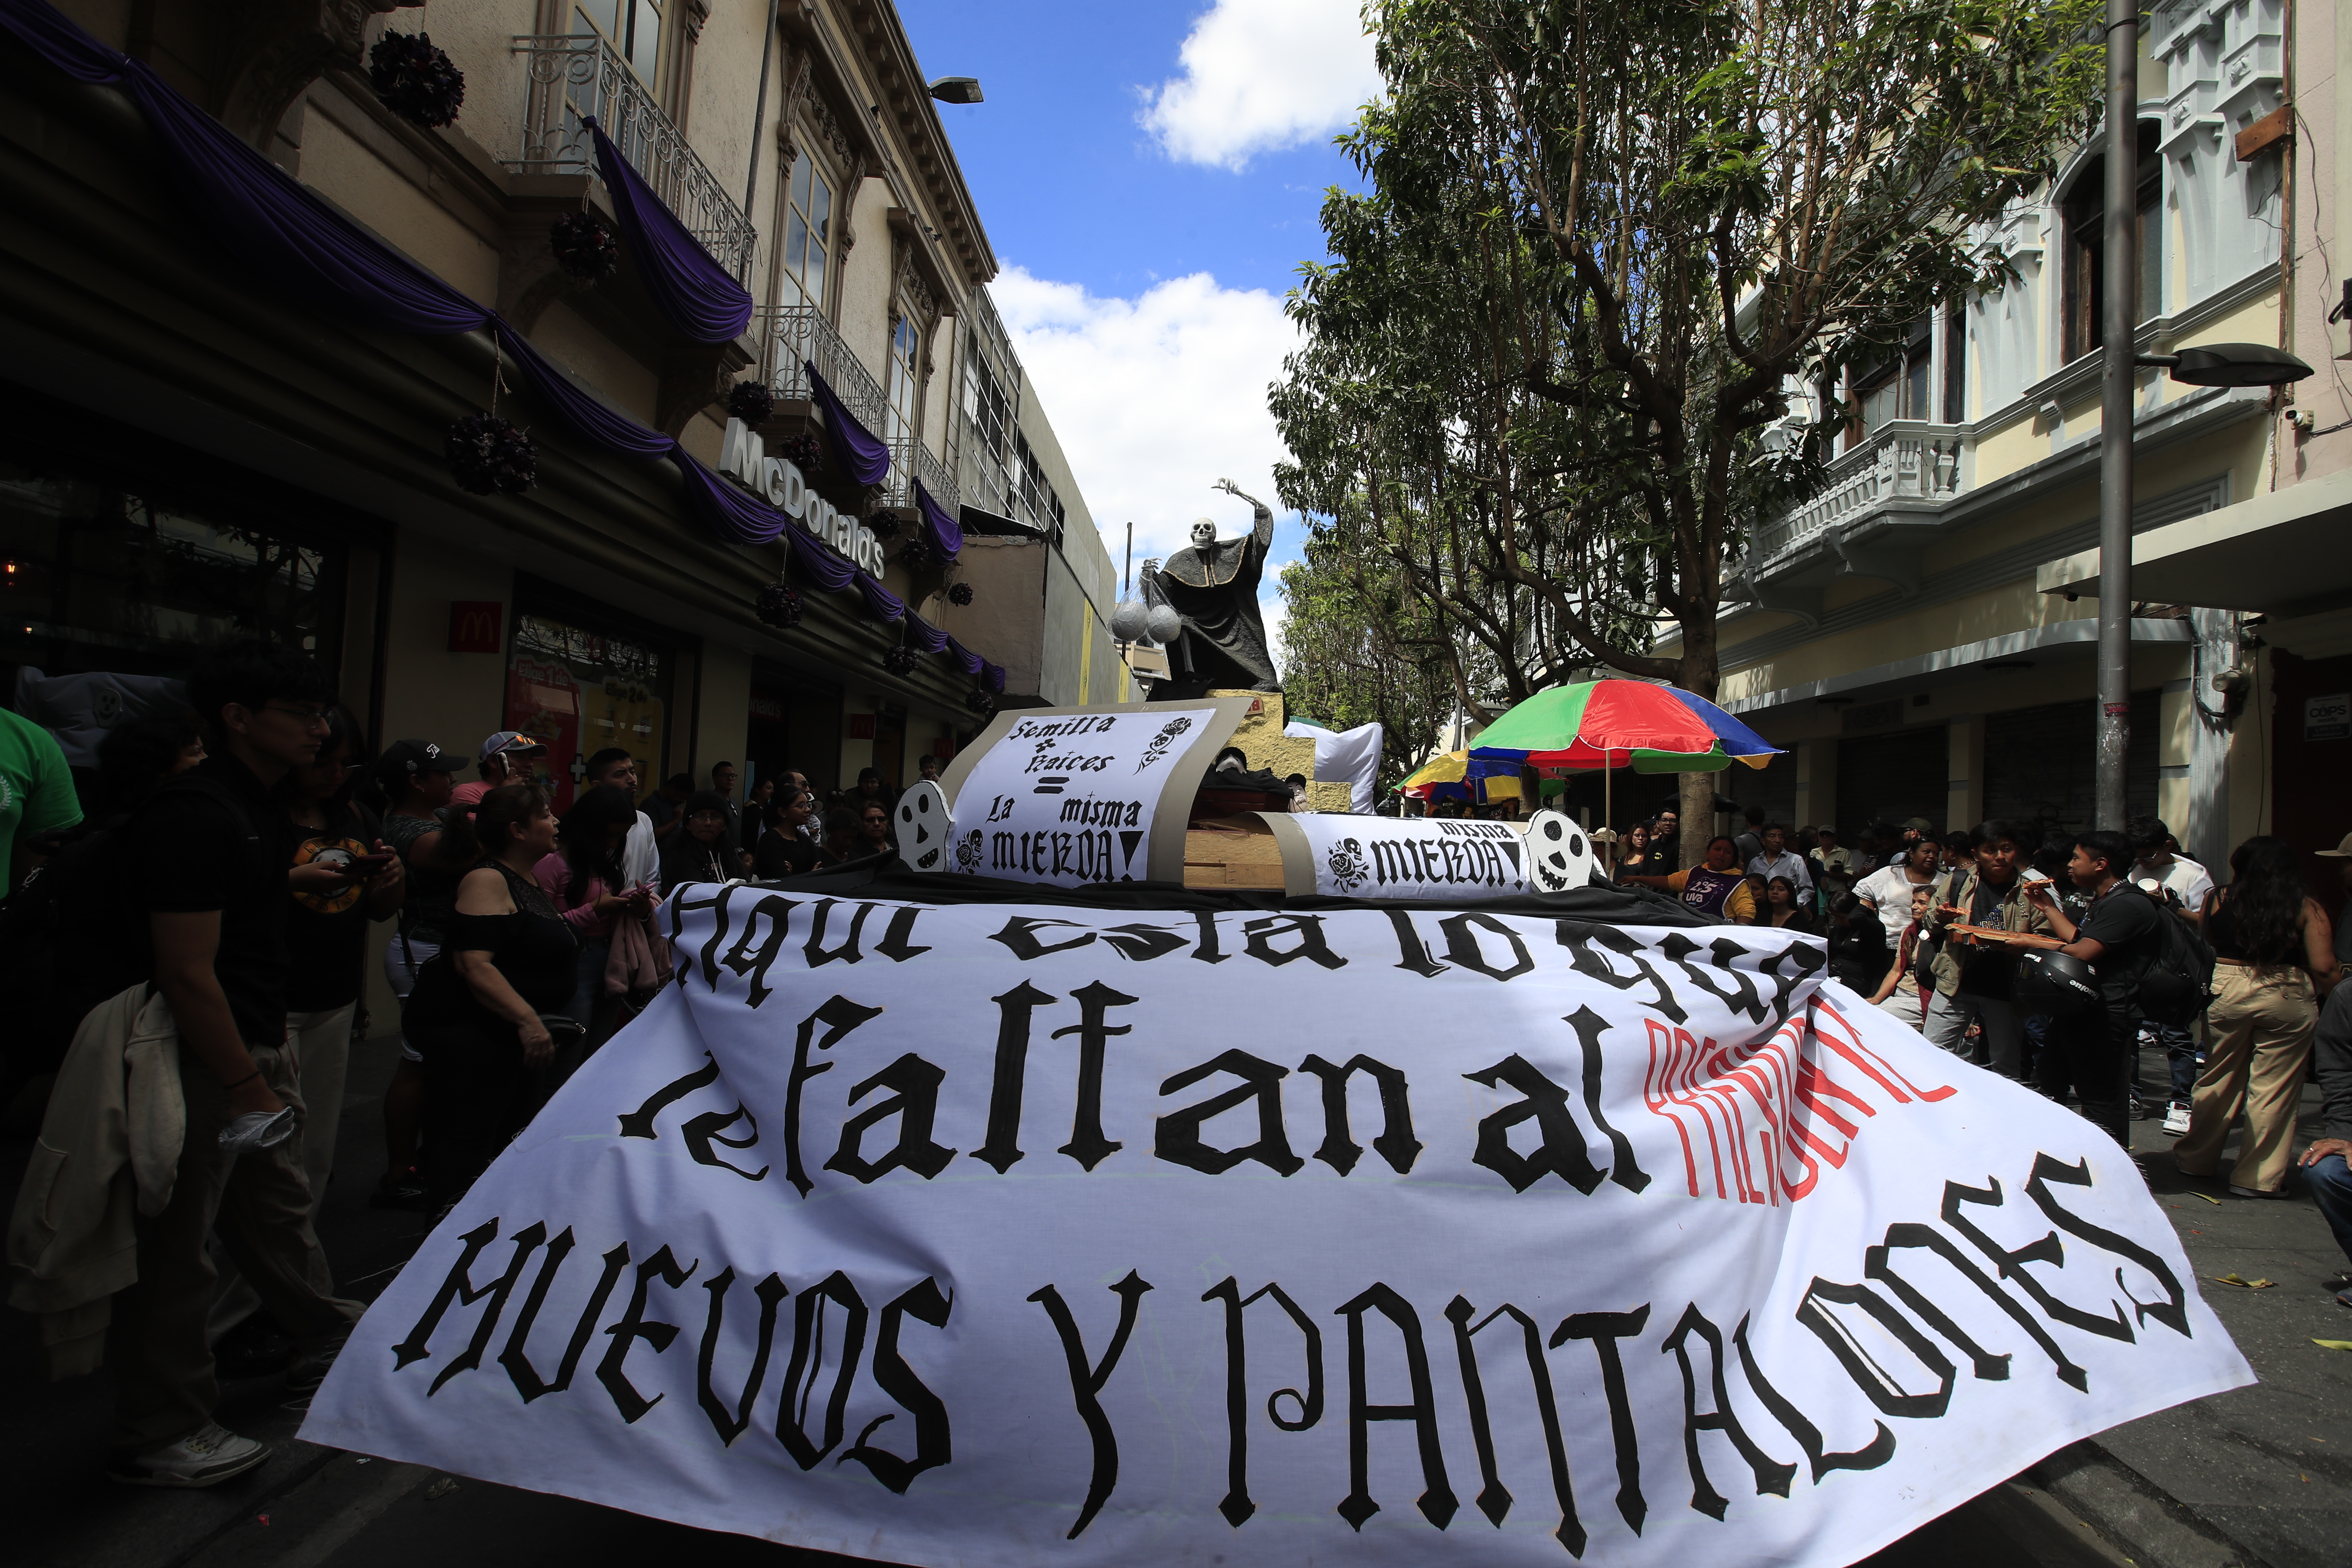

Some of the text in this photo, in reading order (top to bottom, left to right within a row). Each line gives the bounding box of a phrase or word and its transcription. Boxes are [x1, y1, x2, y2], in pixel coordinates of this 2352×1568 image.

[720, 417, 884, 580] McDonald's
[518, 662, 569, 686] Elige 1 de
[605, 683, 647, 704] Elige 2 de
[2309, 704, 2347, 718] COPS
[1008, 716, 1118, 741] Semilla
[1024, 750, 1116, 774] Raices
[985, 791, 1143, 829] La misma
[1436, 819, 1513, 839] misma
[992, 828, 1145, 883] MIERDA!
[1370, 836, 1525, 892] MIERDA!
[1686, 893, 1703, 903] uva
[1462, 1003, 1652, 1196] al
[390, 1151, 2192, 1559] HUEVOS Y PANTALONES
